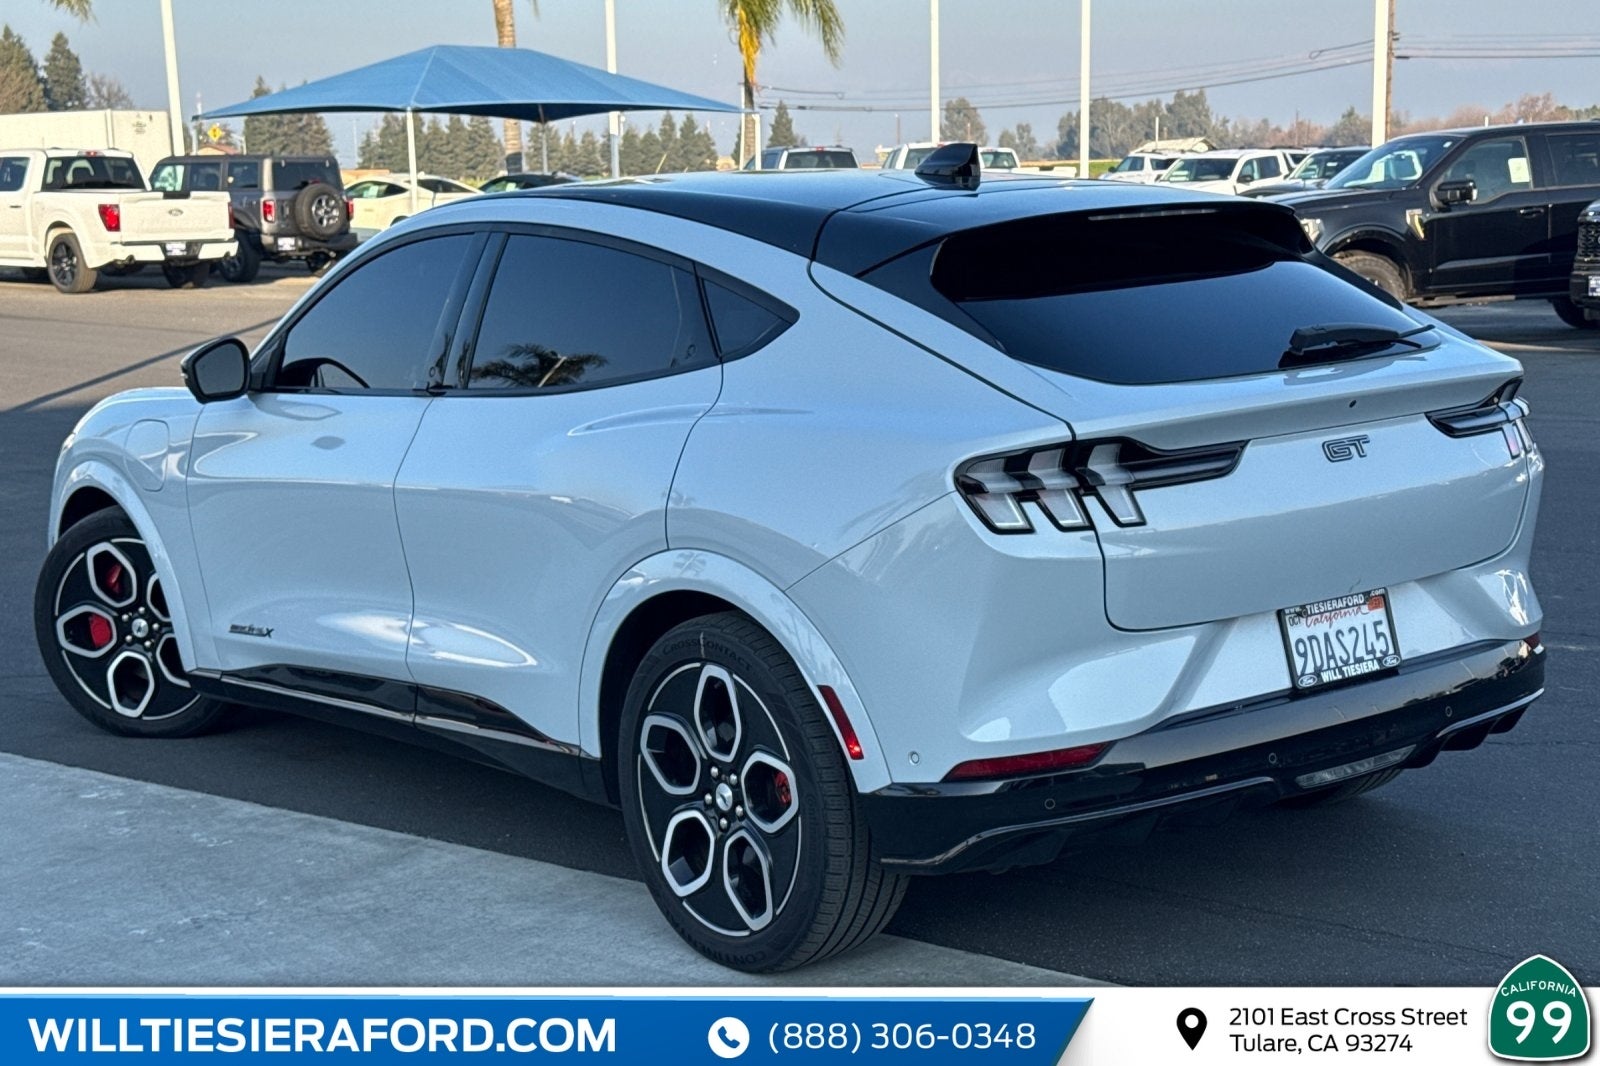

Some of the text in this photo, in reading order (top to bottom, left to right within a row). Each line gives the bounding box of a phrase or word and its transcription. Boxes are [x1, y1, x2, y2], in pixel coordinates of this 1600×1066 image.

[1322, 434, 1370, 463] GT
[1305, 605, 1366, 628] California
[1306, 594, 1364, 615] TIESIERAFORD
[1294, 620, 1389, 676] 9DAS245
[1321, 659, 1379, 683] WILL TIESIERA
